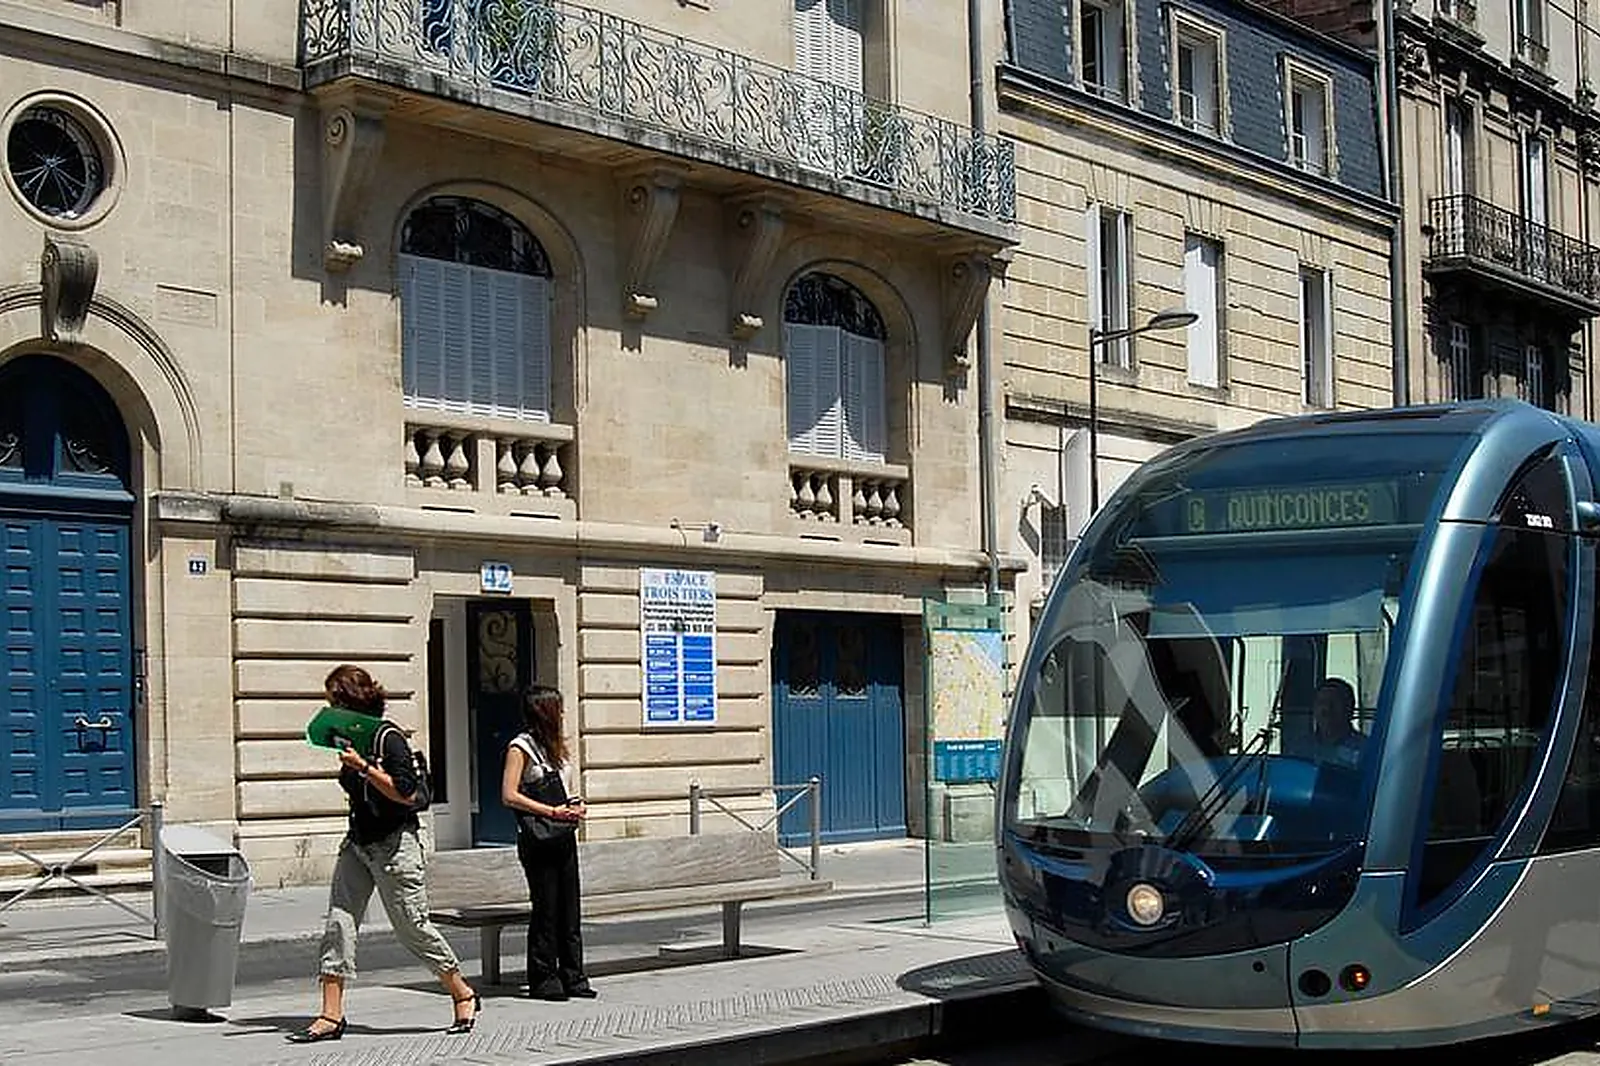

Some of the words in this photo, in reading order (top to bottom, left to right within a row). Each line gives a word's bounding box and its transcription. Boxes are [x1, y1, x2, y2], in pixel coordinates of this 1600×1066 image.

[1228, 489, 1369, 527] QUINCONCES
[484, 564, 509, 588] 42
[664, 571, 708, 586] ESPACE
[643, 586, 679, 599] TROIS
[681, 587, 714, 601] TIERS
